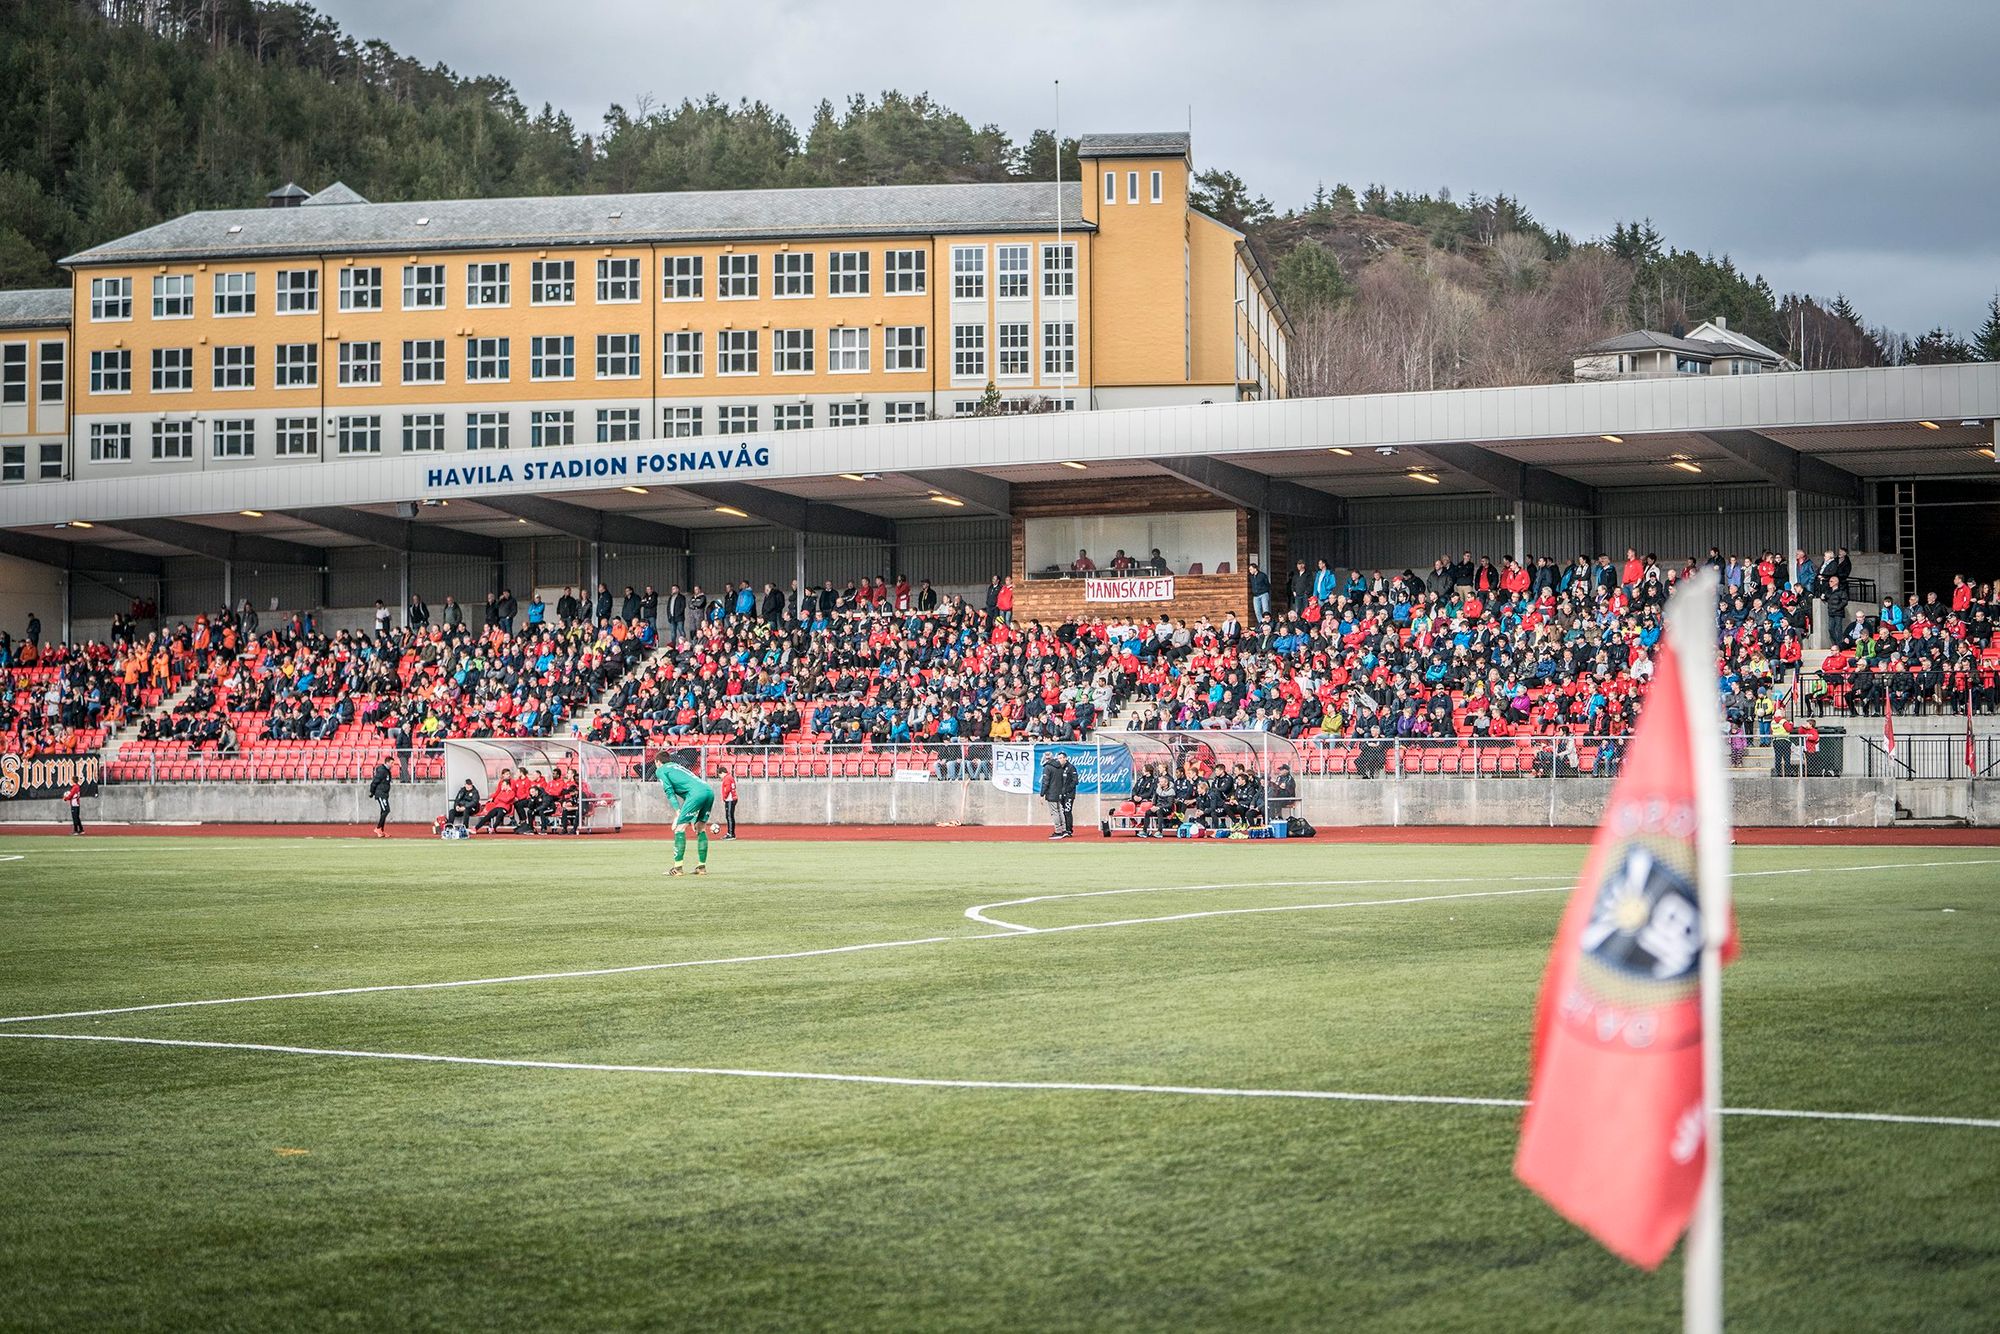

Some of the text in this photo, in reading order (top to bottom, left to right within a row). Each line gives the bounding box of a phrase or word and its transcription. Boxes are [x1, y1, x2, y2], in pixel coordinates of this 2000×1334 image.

[428, 443, 769, 487] HAVILA STADION FOSNAVÅG
[1087, 580, 1171, 598] MANNSKAPET
[996, 751, 1030, 761] FAIR
[1064, 751, 1096, 766] andler
[996, 761, 1031, 771] PLAY
[0, 753, 98, 797] Stormen
